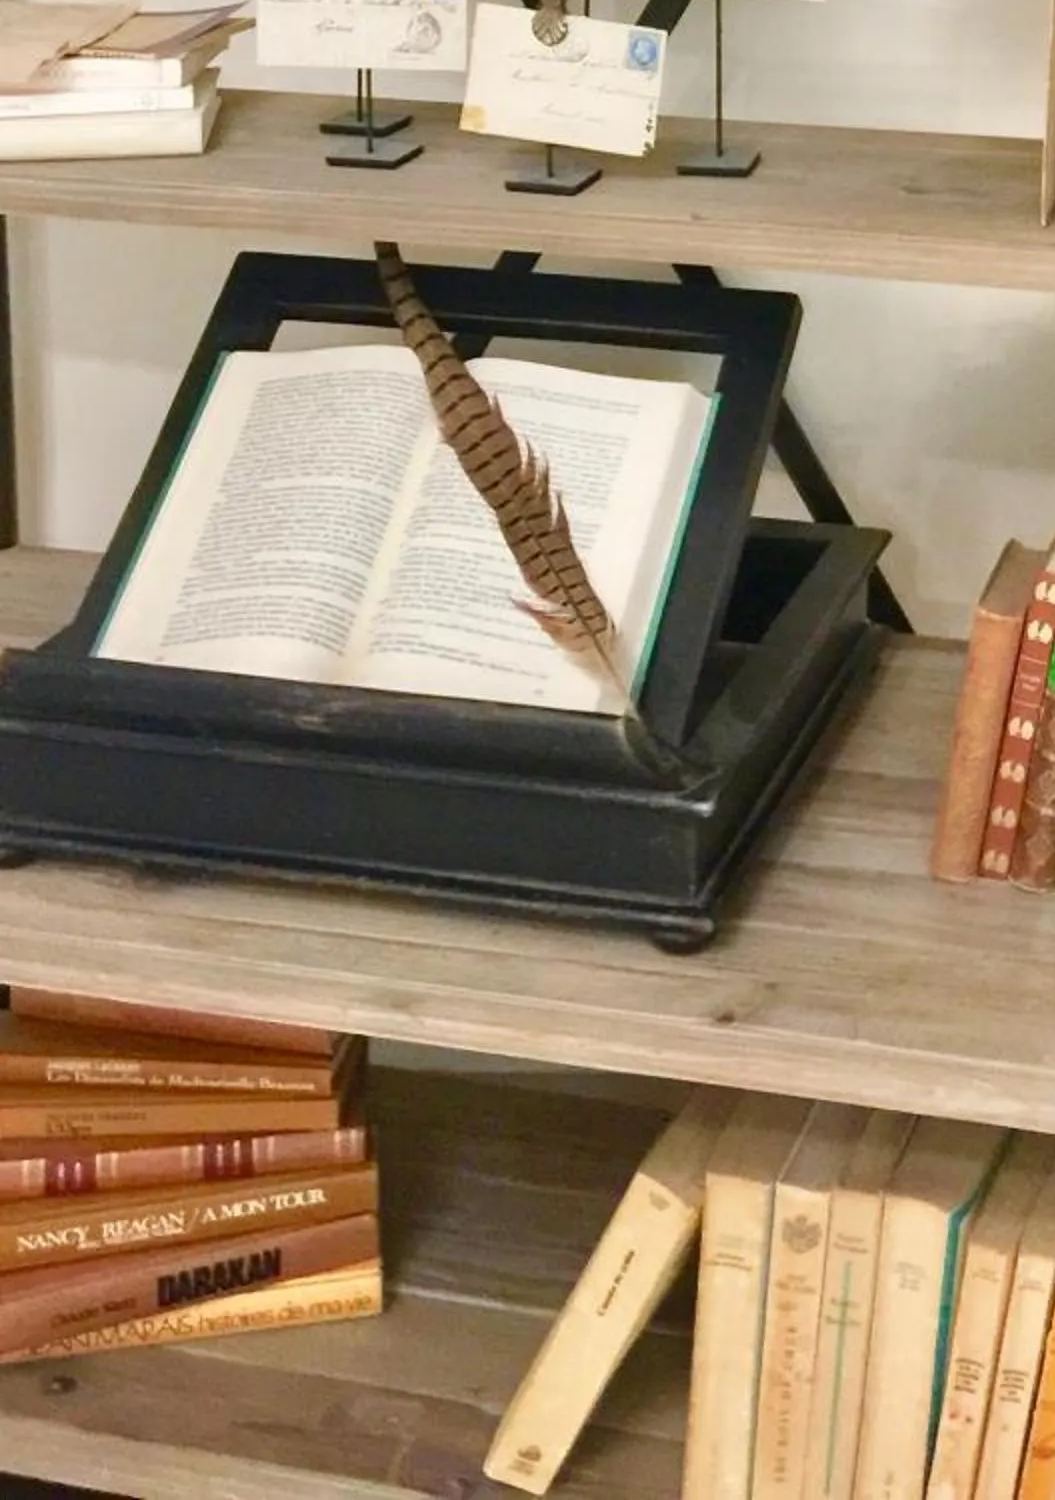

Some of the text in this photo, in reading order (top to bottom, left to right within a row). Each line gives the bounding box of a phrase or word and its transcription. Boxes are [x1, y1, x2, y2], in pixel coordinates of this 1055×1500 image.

[15, 1224, 90, 1252] NANCY
[101, 1209, 186, 1240] REAGAN
[219, 1197, 267, 1219] MON
[269, 1187, 329, 1211] TOUR
